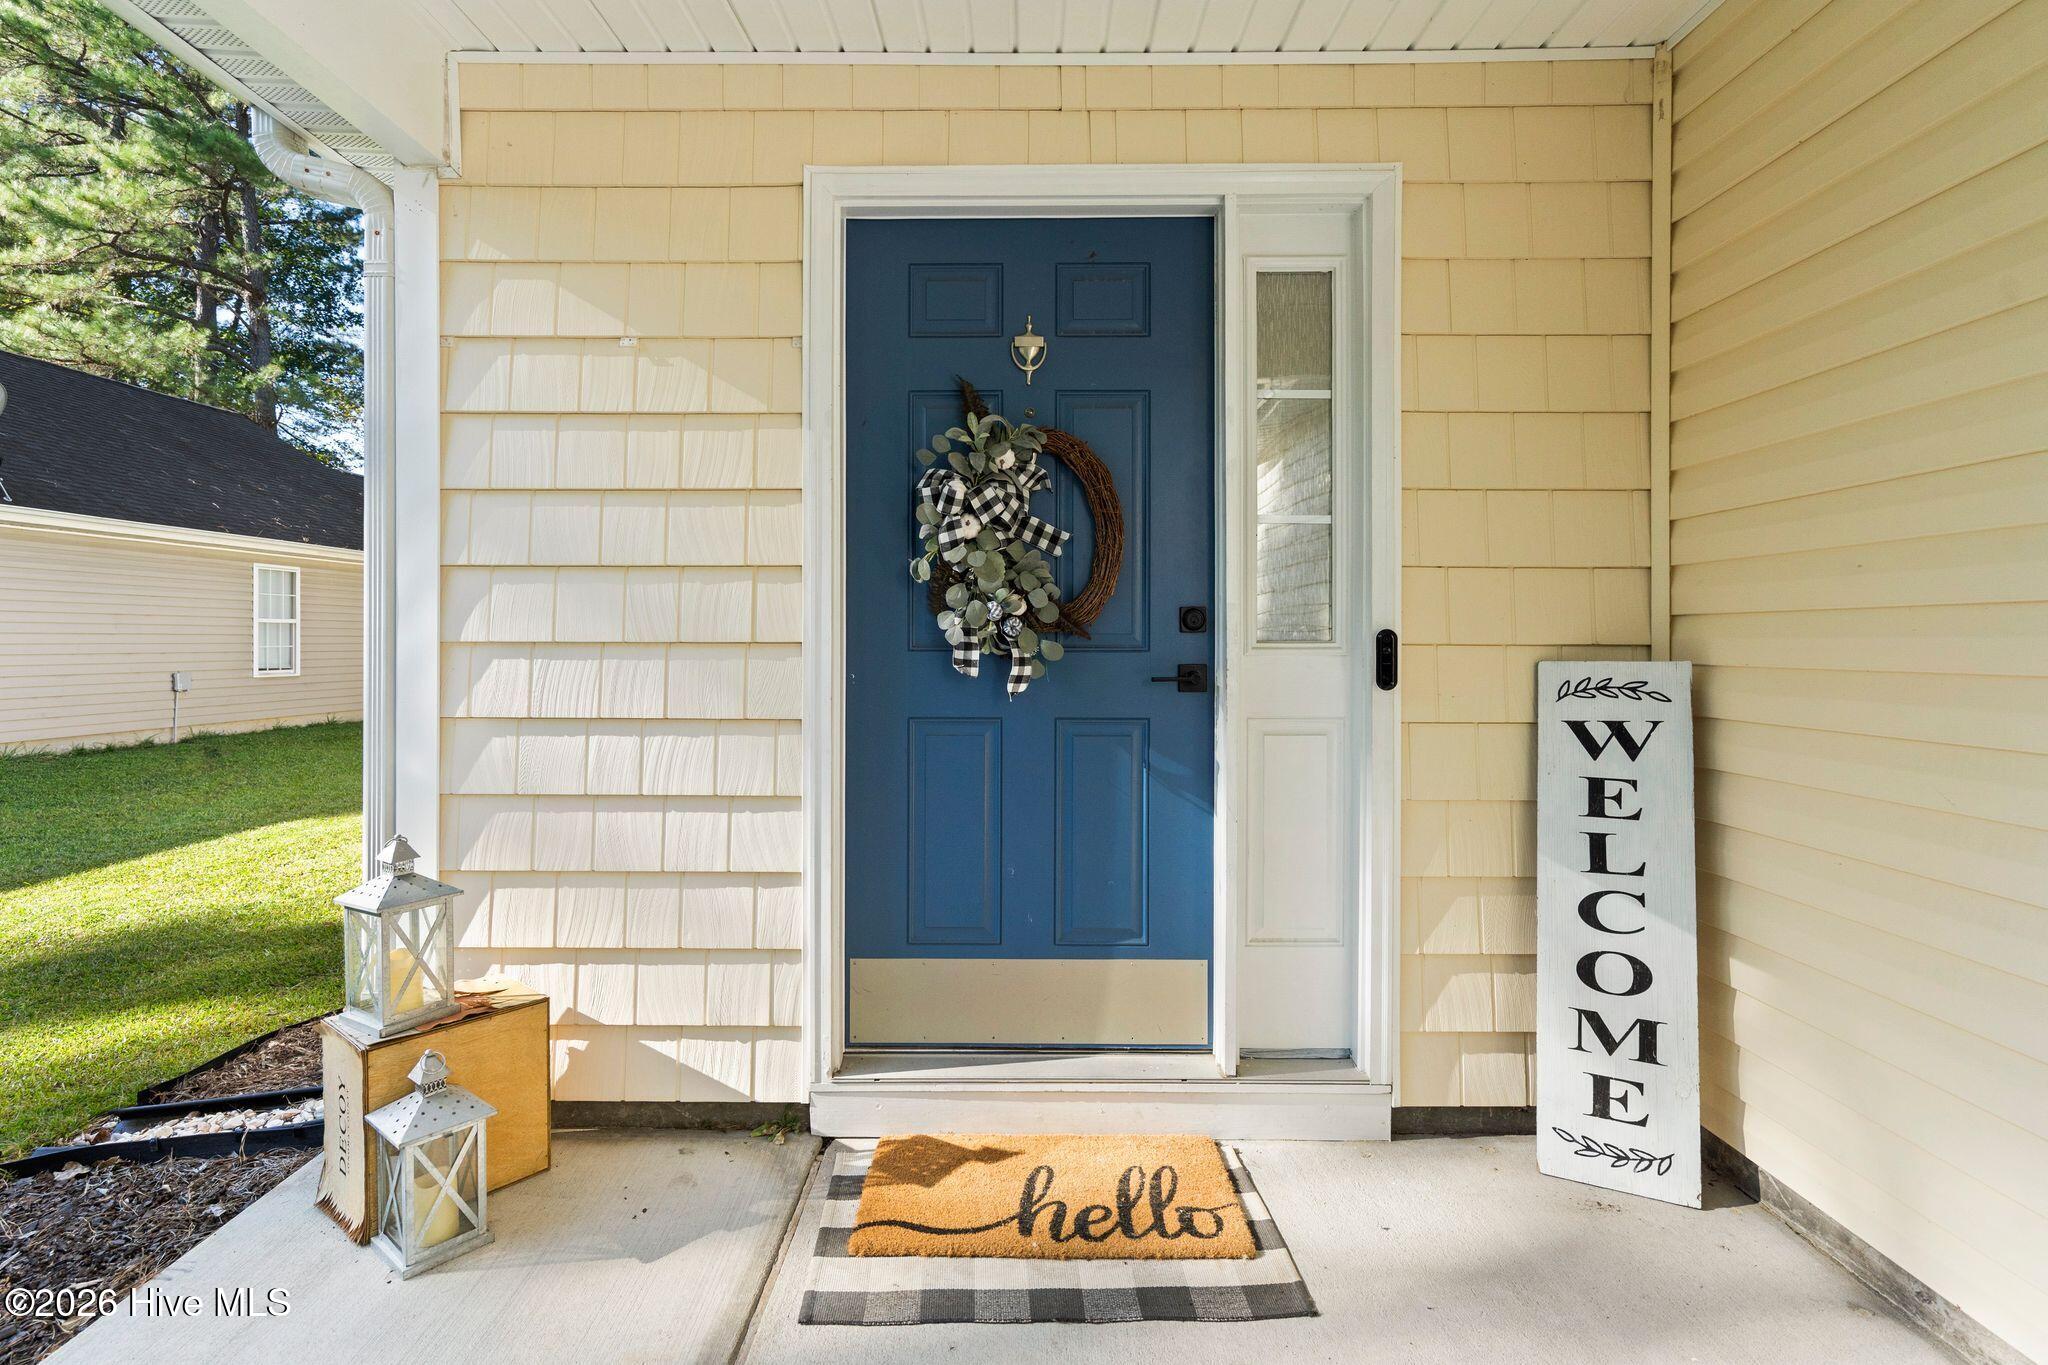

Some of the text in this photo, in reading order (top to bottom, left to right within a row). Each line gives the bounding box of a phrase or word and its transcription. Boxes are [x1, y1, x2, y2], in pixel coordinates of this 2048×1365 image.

[1560, 719, 1669, 1128] WELCOME
[338, 1074, 346, 1176] DECOY
[1013, 1164, 1239, 1244] hello
